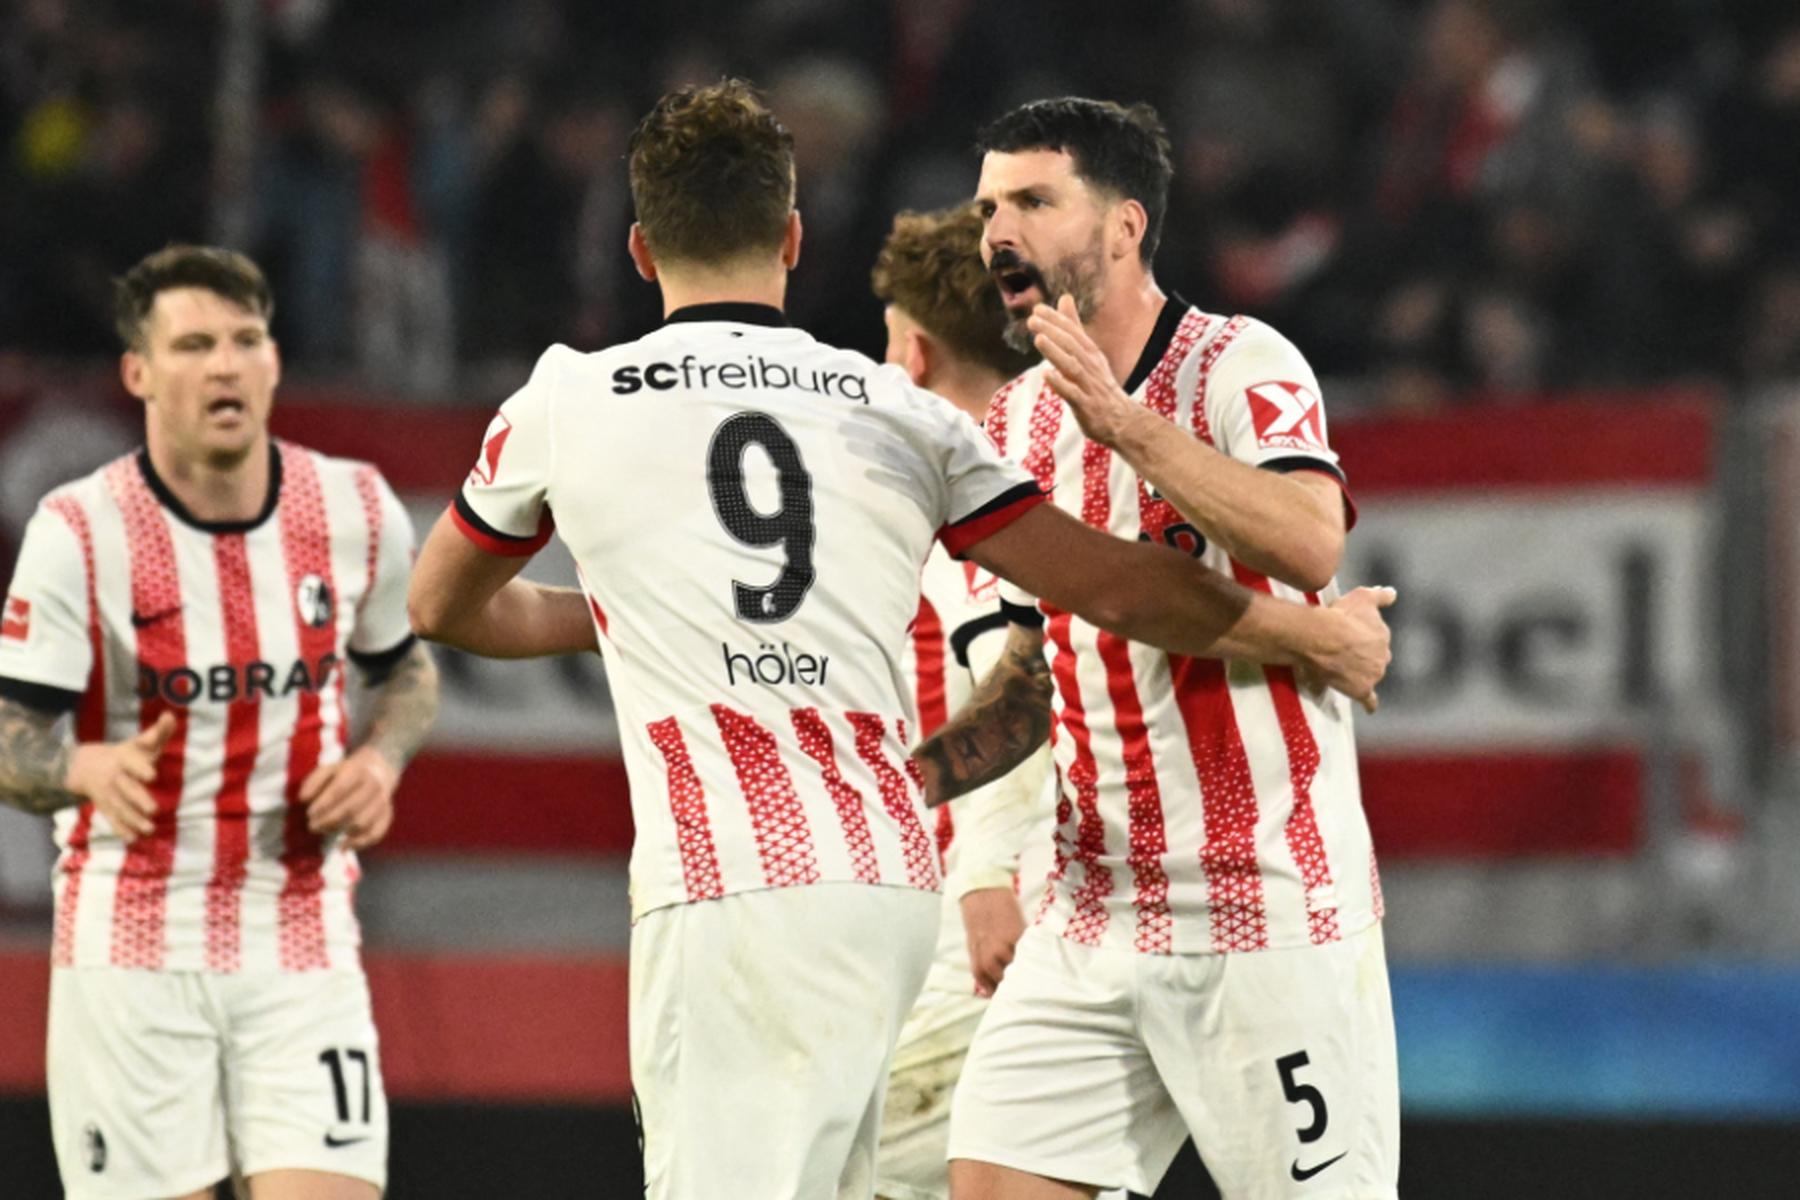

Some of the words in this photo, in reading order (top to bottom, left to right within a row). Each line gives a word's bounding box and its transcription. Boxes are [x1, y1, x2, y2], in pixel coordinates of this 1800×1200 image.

[611, 354, 870, 405] scfreiburg
[705, 410, 816, 625] 9
[722, 642, 829, 687] höler
[319, 1047, 371, 1124] 17
[1275, 1049, 1328, 1144] 5
